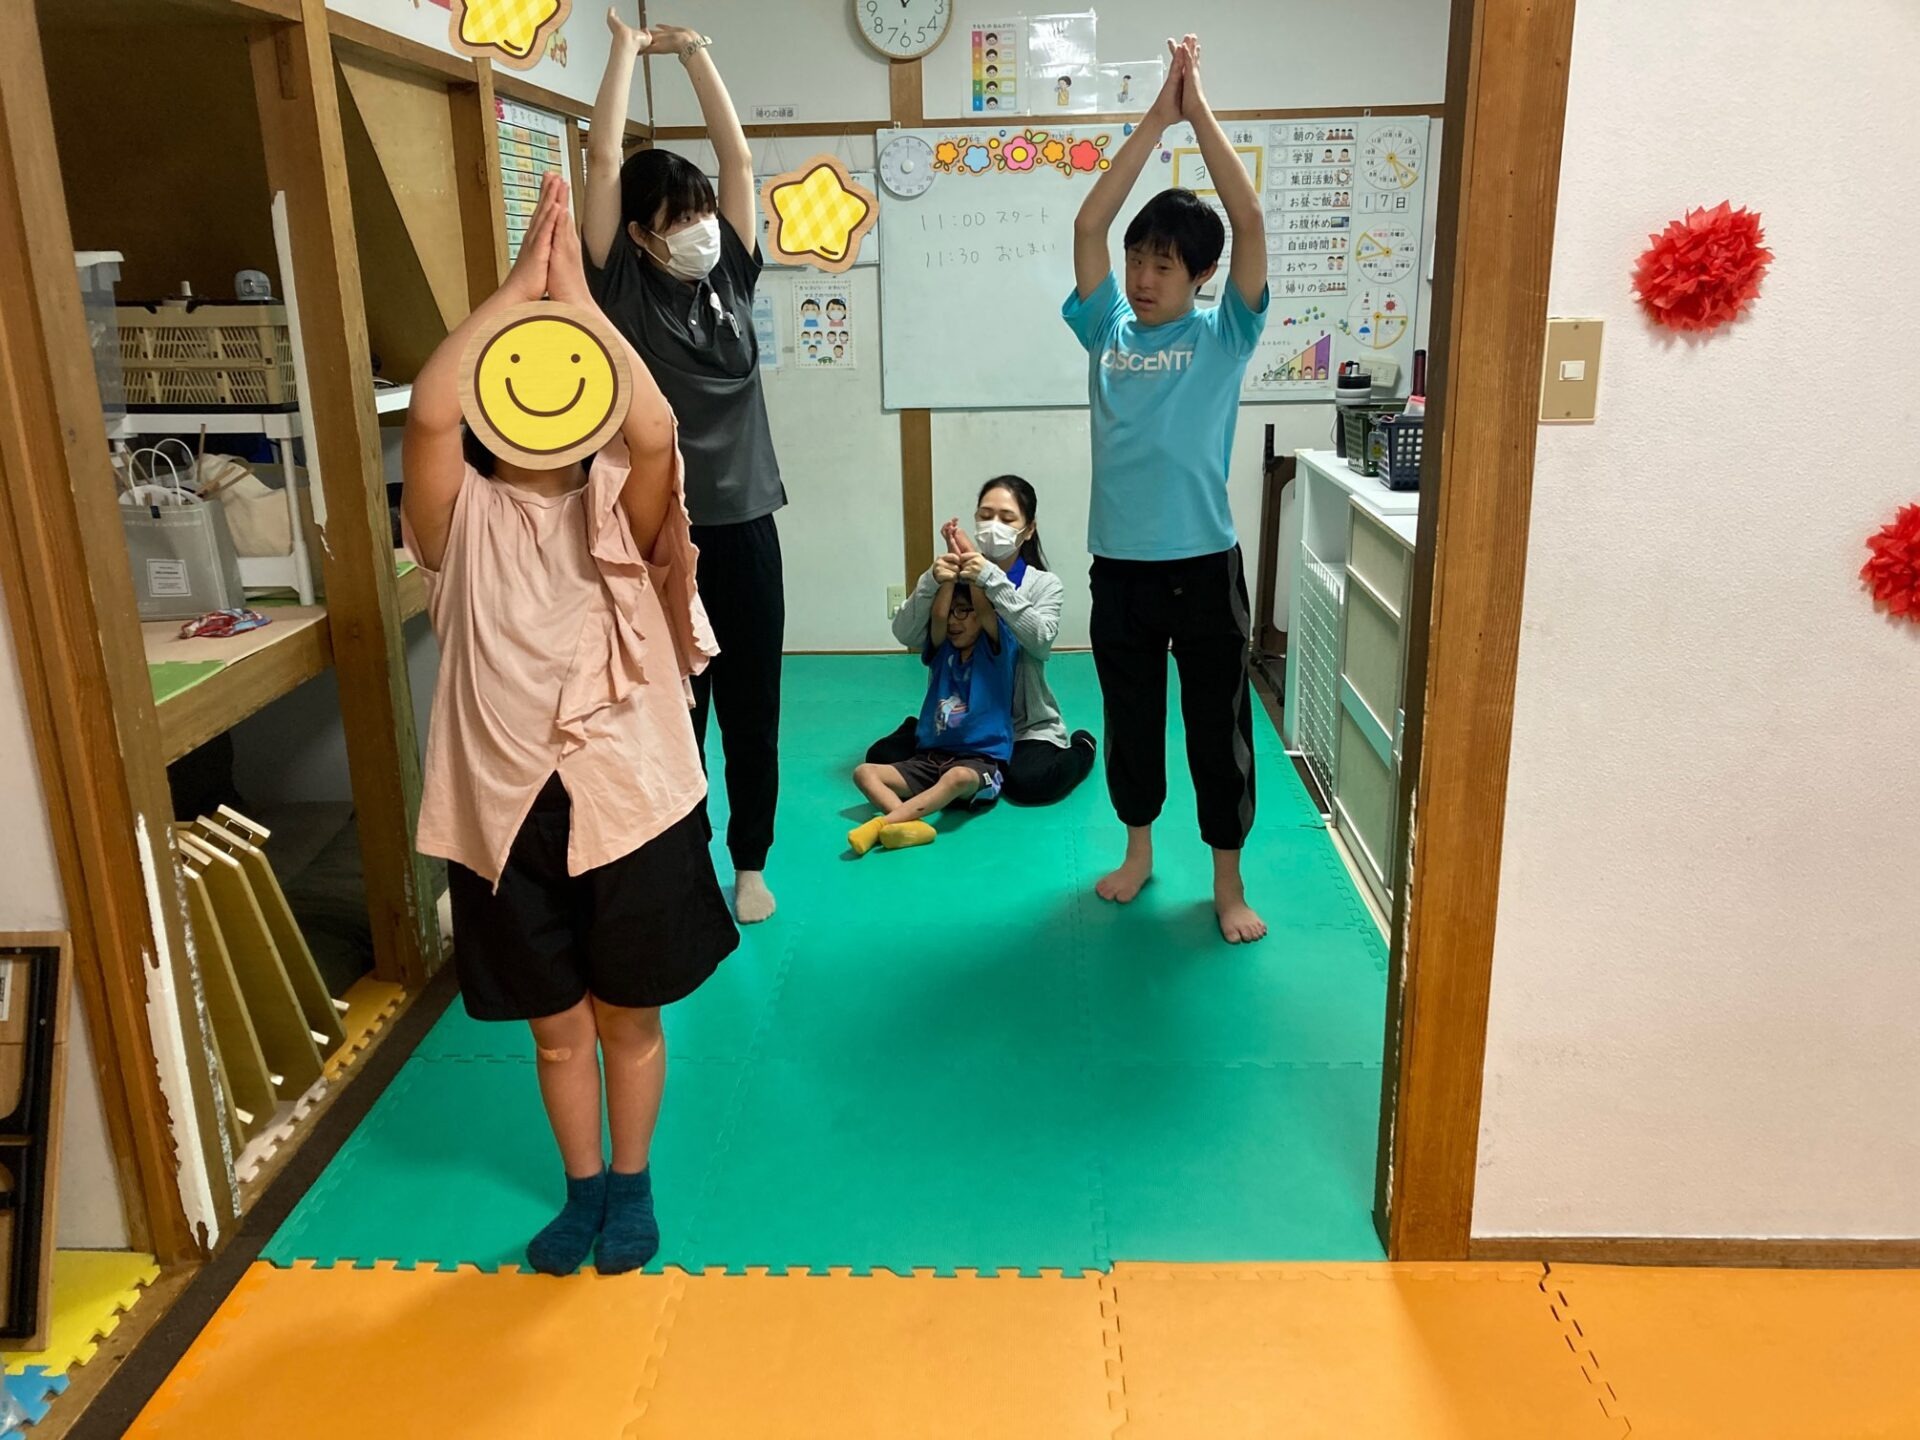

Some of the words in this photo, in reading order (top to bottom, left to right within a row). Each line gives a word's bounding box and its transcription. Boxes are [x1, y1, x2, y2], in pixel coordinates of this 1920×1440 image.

[866, 0, 878, 17] 9
[874, 17, 884, 34] 8
[926, 15, 937, 31] 4
[887, 27, 899, 44] 7
[899, 31, 911, 48] 6
[916, 26, 926, 43] 5
[1293, 131, 1325, 142] 朝の会
[1292, 152, 1314, 164] 学習
[1290, 172, 1334, 186] 集団活動
[1289, 195, 1332, 208] お昼ご飯
[1289, 216, 1331, 230] お腹休め
[1287, 240, 1330, 251] 自由時間
[1286, 260, 1318, 272] おやつ
[1285, 282, 1327, 294] 帰りの会
